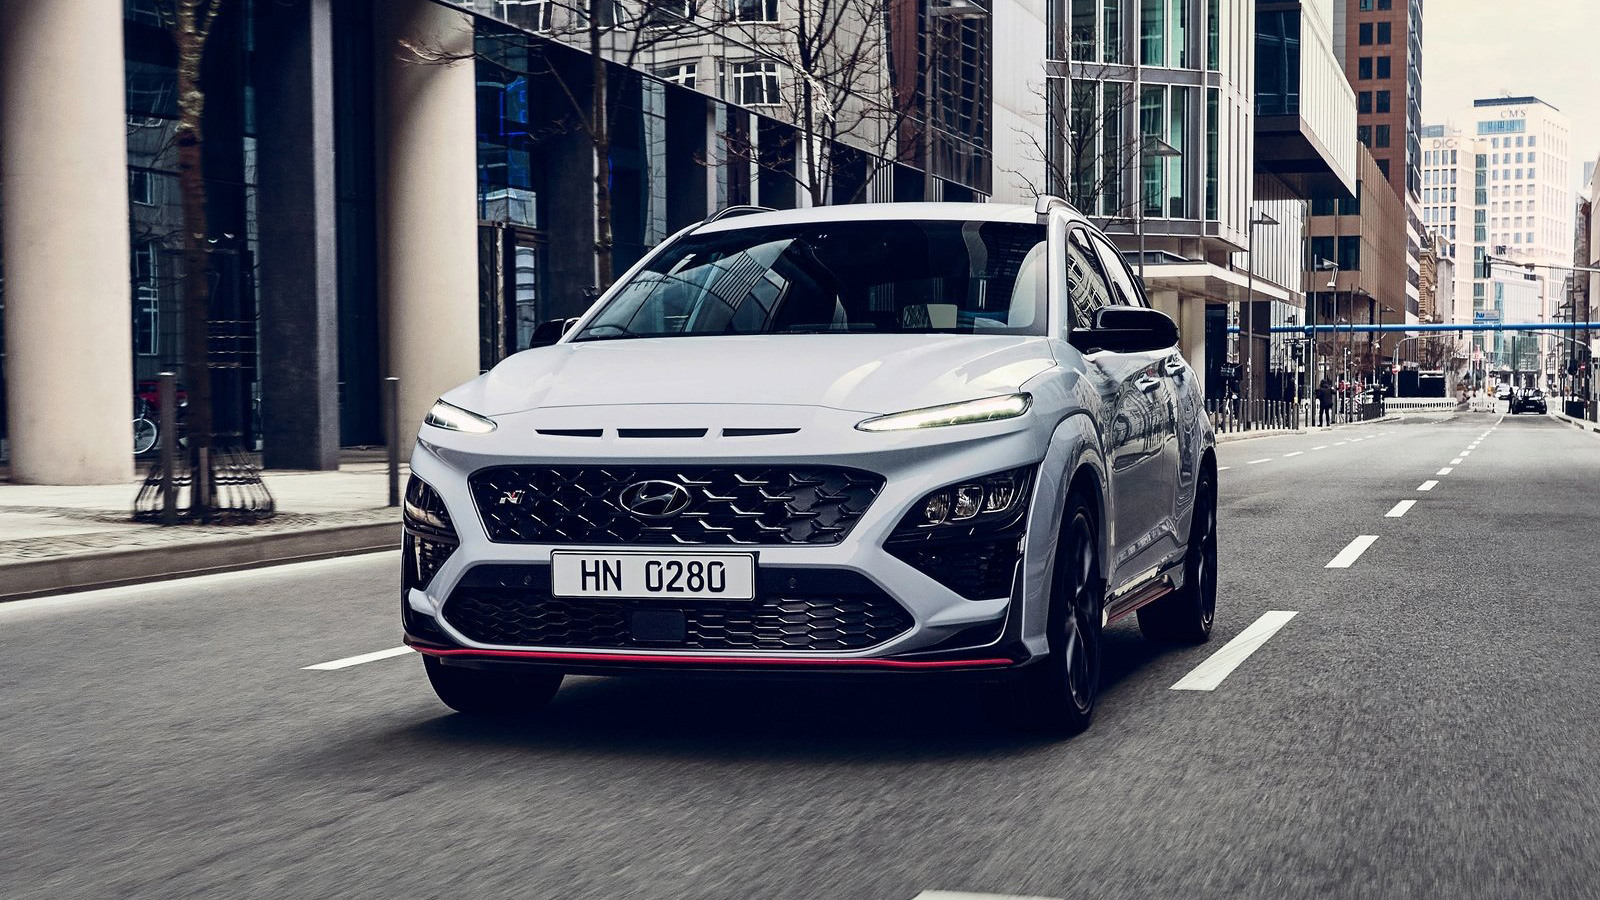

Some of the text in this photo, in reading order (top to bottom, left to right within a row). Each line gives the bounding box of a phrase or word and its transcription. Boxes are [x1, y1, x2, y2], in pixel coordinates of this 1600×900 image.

[1500, 109, 1526, 118] CMS
[581, 560, 726, 593] HN 0280
